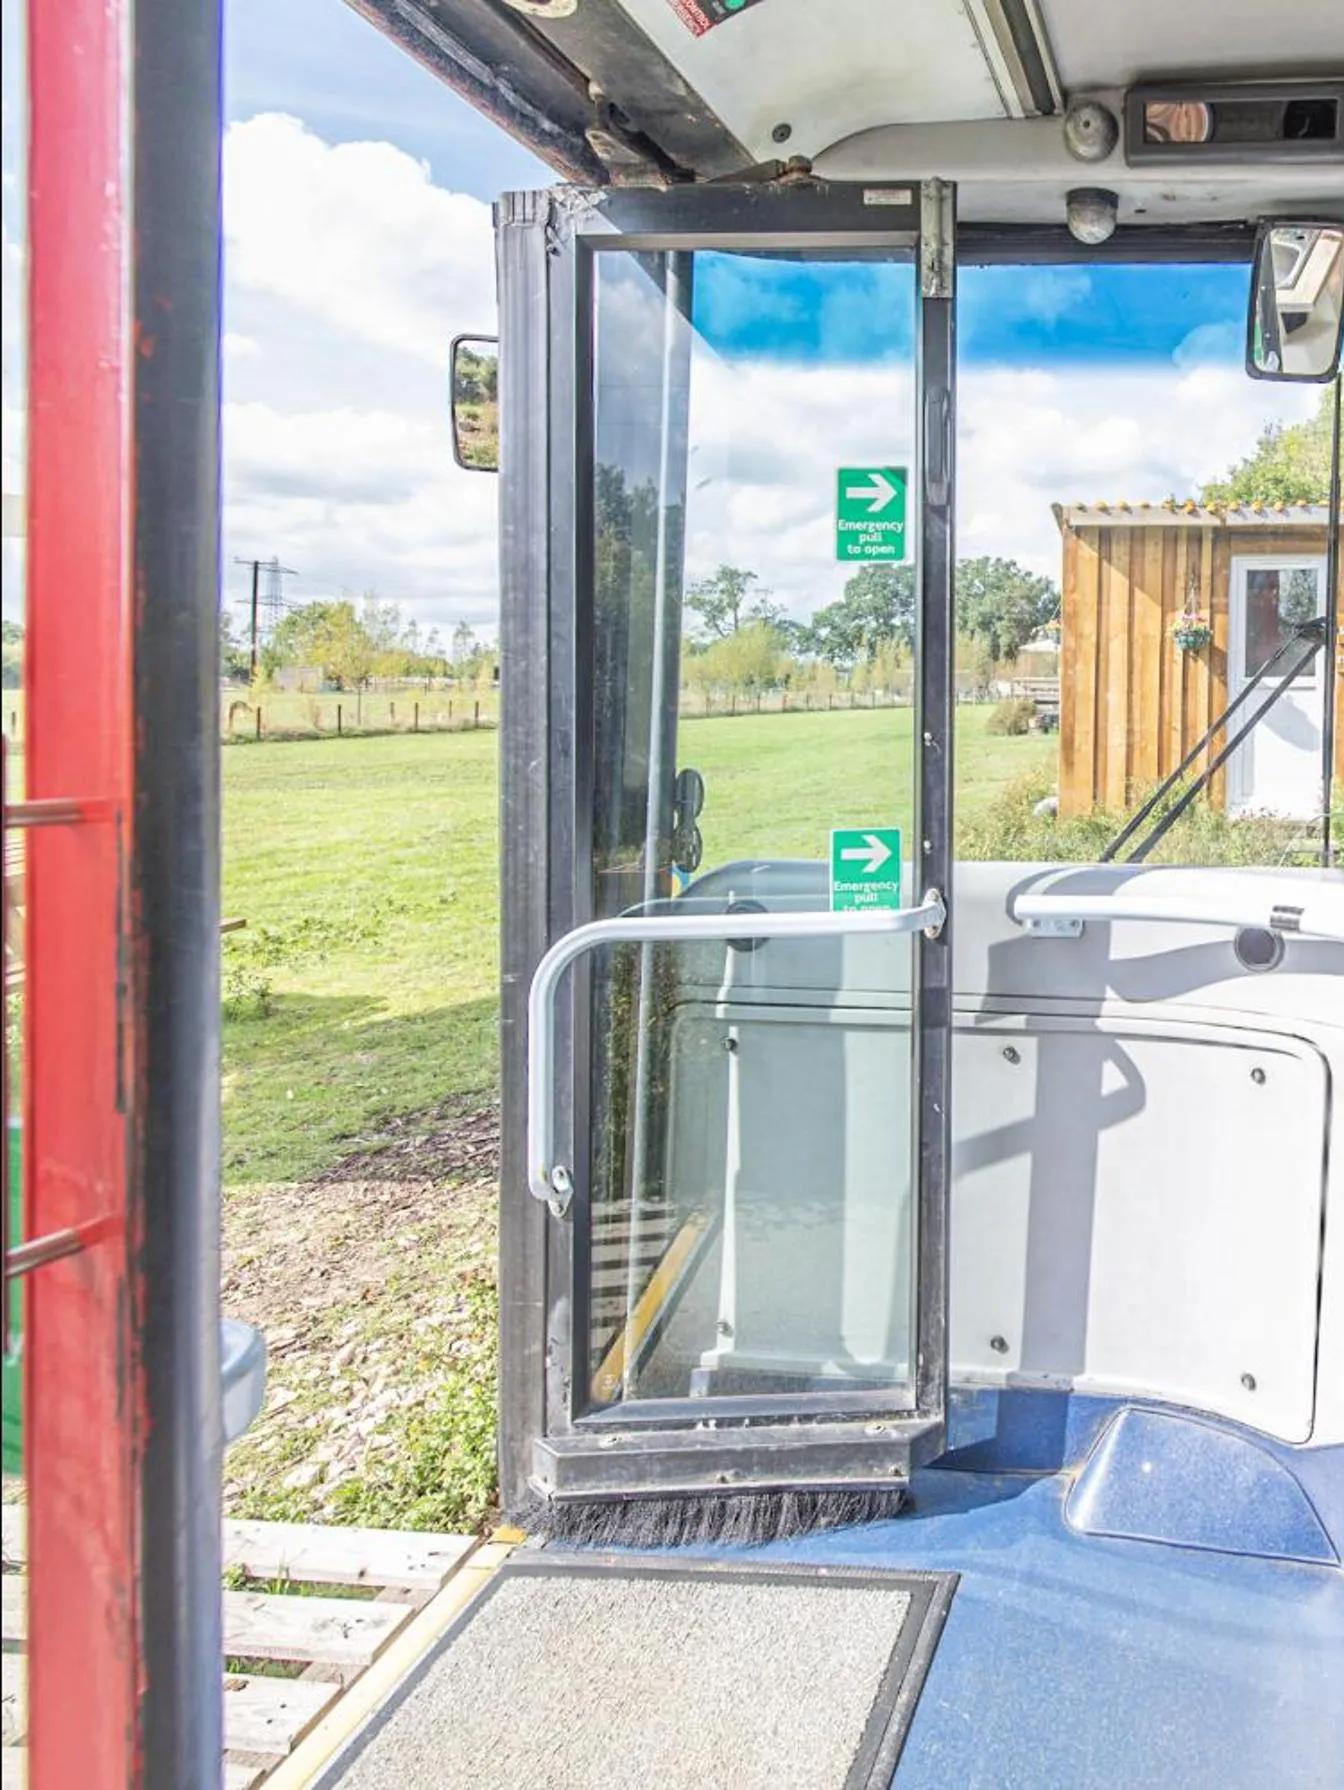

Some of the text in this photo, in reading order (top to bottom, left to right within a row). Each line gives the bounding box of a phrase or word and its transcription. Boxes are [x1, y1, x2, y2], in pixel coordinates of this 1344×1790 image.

[838, 519, 904, 533] Emergency
[859, 531, 882, 544] pull
[847, 544, 896, 556] to open
[834, 881, 897, 893] Emergency
[854, 893, 878, 904] pull
